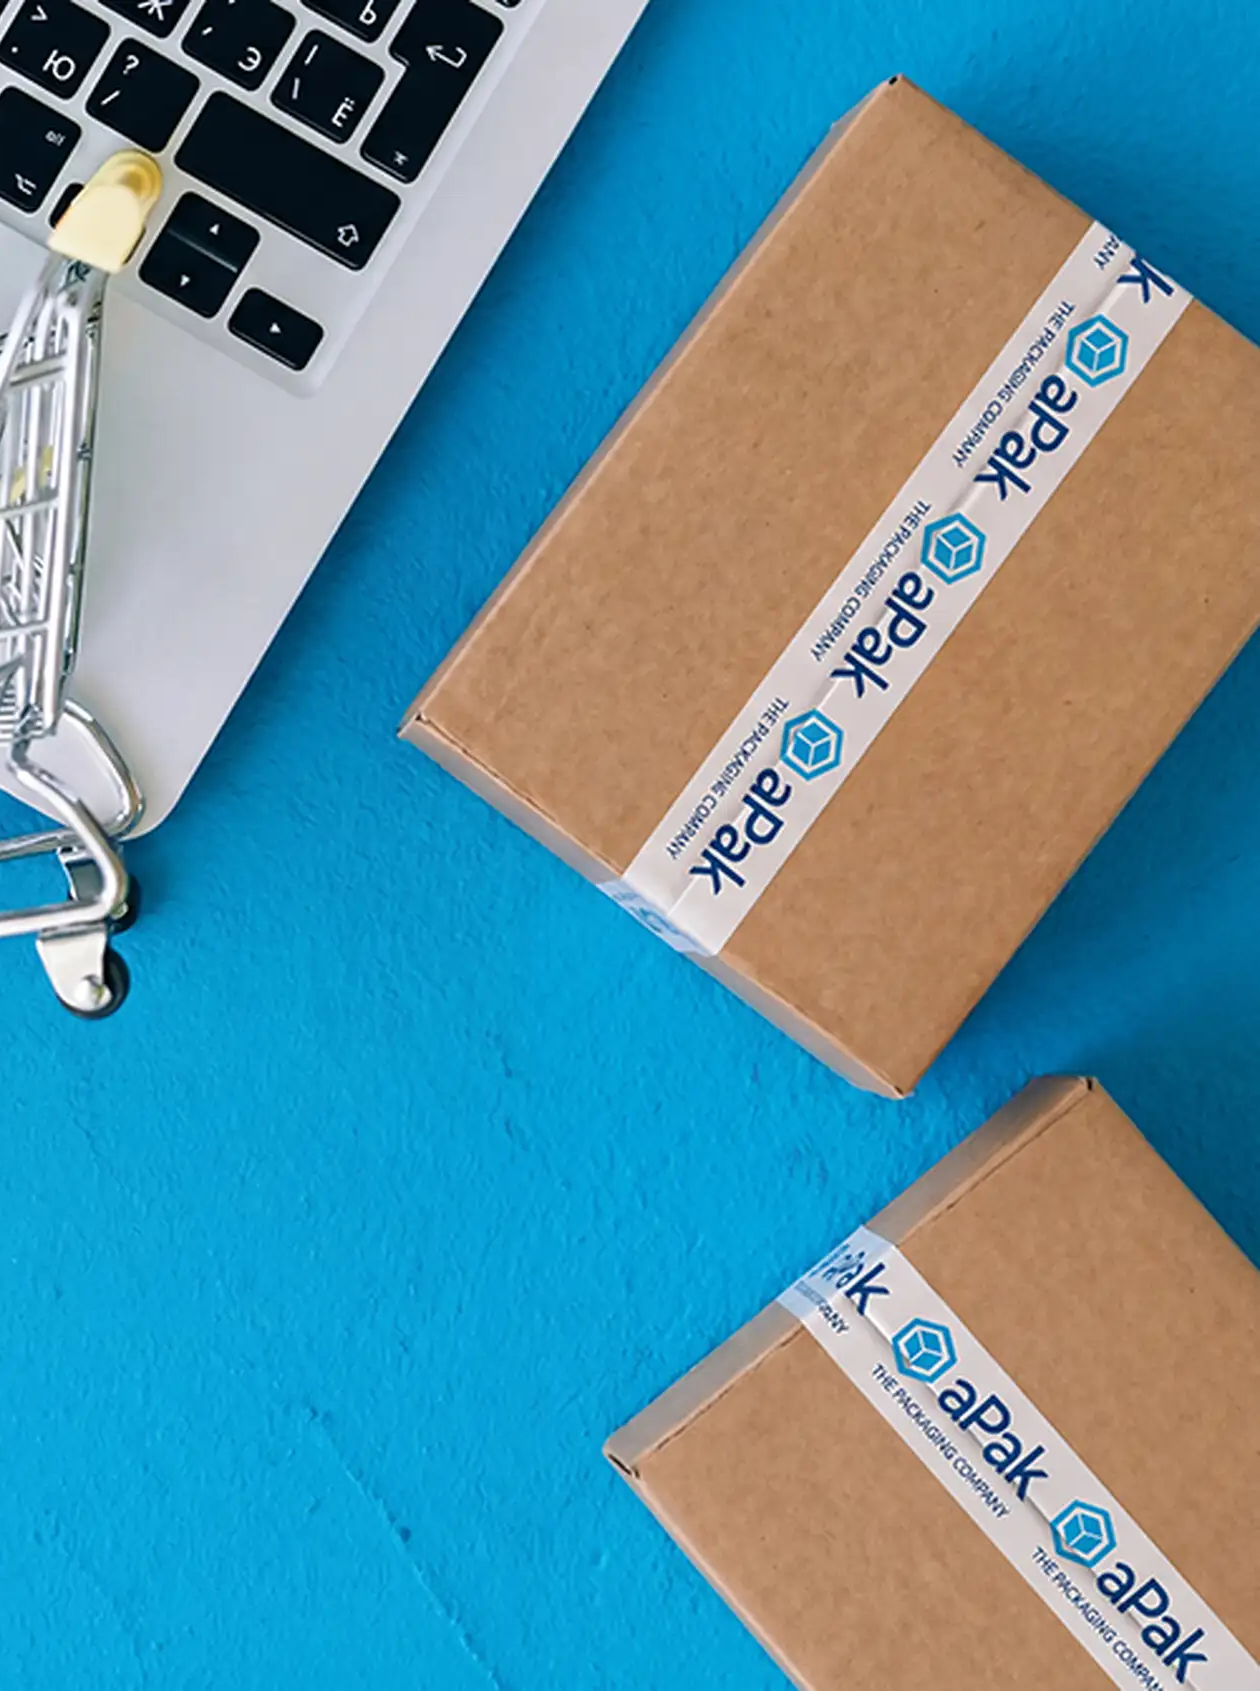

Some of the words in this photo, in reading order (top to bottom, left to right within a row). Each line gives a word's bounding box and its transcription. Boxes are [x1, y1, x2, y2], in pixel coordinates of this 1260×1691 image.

[41, 49, 76, 82] Ю
[1047, 300, 1076, 331] THE
[996, 327, 1056, 403] PACKAGING
[952, 397, 1004, 469] COMPANY
[974, 374, 1078, 500] aPak
[904, 500, 932, 531] THE
[853, 525, 912, 599] PACKAGING
[810, 596, 862, 662] COMPANY
[830, 571, 935, 699] aPak
[760, 697, 790, 726] THE
[710, 721, 769, 798] PACKAGING
[665, 794, 718, 861] COMPANY
[689, 767, 793, 896] aPak
[871, 1362, 899, 1393] THE
[891, 1387, 958, 1461] PACKAGING
[952, 1456, 1011, 1519] COMPANY
[937, 1378, 1049, 1502] aPak
[1032, 1545, 1059, 1577] THE
[1051, 1570, 1118, 1644] PACKAGING
[1096, 1561, 1208, 1685] aPak
